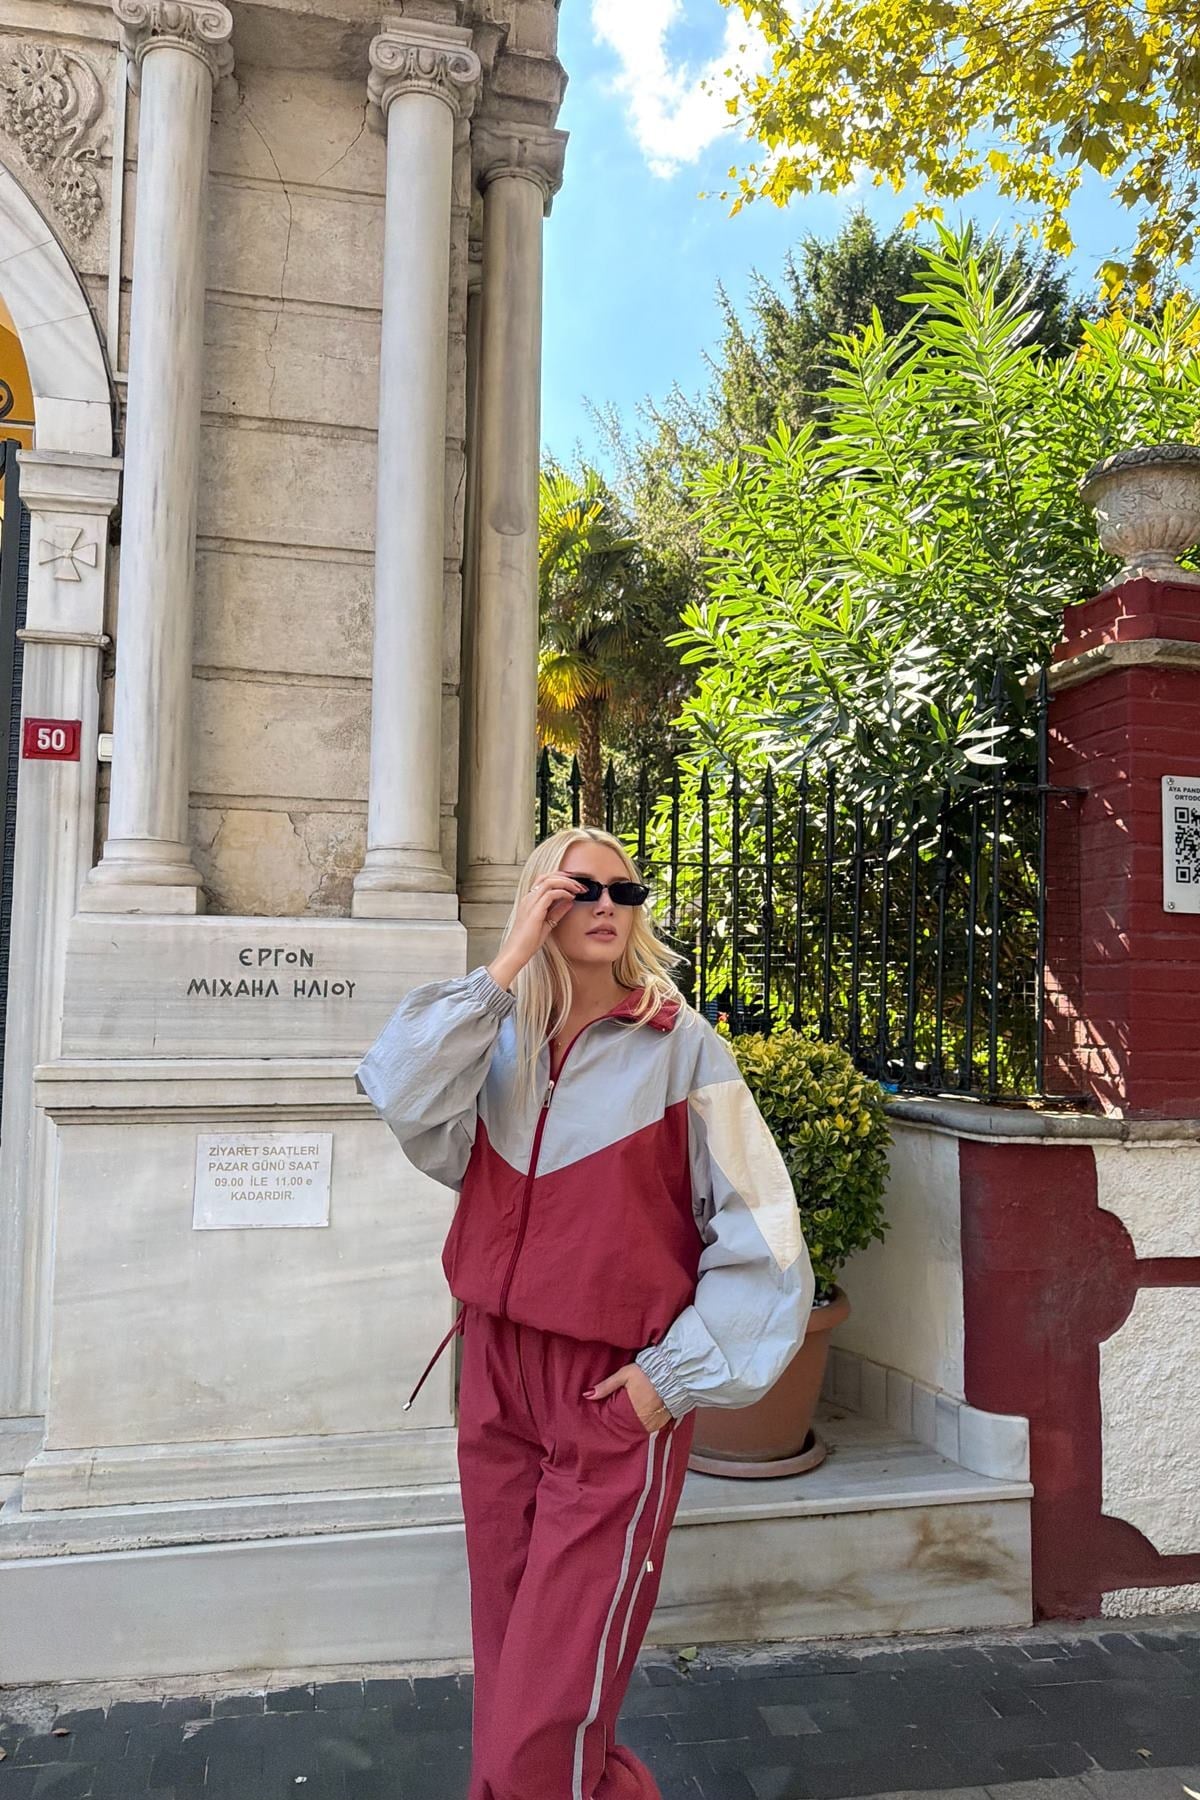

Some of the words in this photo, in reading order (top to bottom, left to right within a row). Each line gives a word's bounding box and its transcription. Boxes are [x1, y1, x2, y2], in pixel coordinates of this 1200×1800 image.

[37, 727, 66, 751] 50
[187, 978, 279, 998] ΜΙΧΑΗΛ
[294, 979, 356, 998] ΗΛΙΟΥ
[208, 1144, 259, 1157] ZİYARET
[262, 1144, 319, 1156] SAATLERİ
[208, 1162, 249, 1172] PAZAR
[252, 1160, 286, 1172] GÜNÜ
[288, 1161, 320, 1171] SAAT
[214, 1177, 244, 1187] 09.00
[250, 1175, 268, 1187] İLE
[275, 1176, 303, 1187] 11.00
[230, 1191, 296, 1201] KADARDIR.
